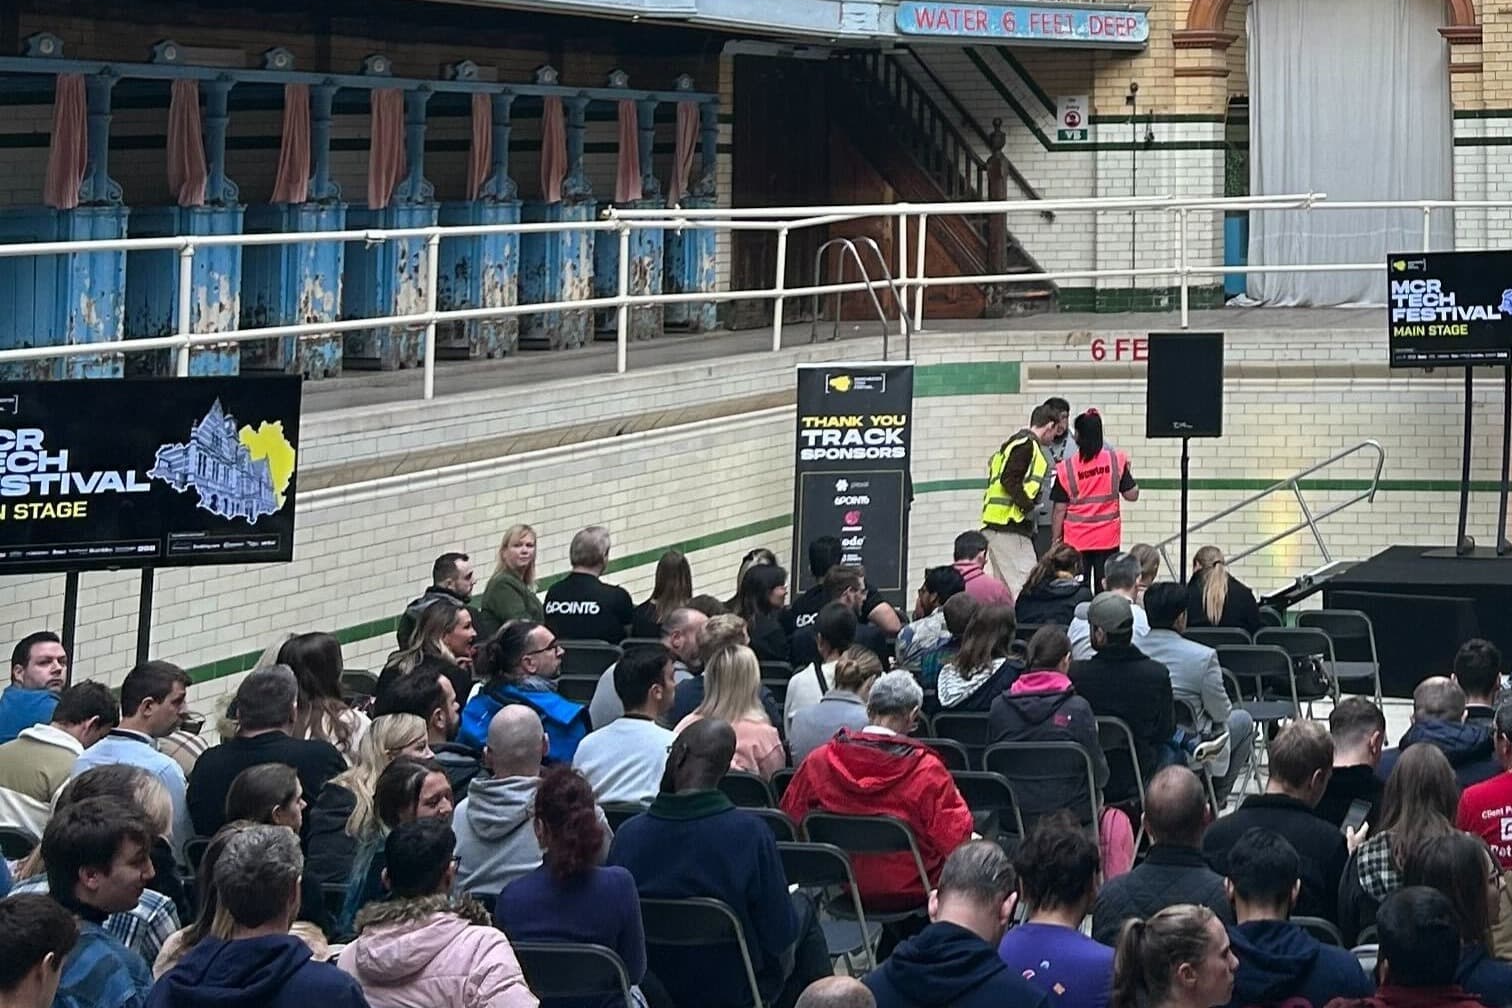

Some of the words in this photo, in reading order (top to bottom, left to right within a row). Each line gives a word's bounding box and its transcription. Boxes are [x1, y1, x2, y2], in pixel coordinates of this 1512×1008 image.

[914, 7, 987, 32] WATER
[1002, 11, 1016, 33] 6
[1030, 13, 1073, 35] FEET
[1088, 15, 1137, 37] DEEP
[1391, 279, 1442, 294] MCR
[1392, 292, 1456, 307] TECH
[1392, 305, 1502, 322] FESTIVAL
[1393, 325, 1425, 336] MAIN
[1428, 324, 1469, 336] STAGE
[1091, 338, 1106, 361] 6
[1115, 338, 1148, 361] FE
[801, 415, 863, 429] THANK
[870, 414, 906, 427] YOU
[0, 428, 45, 450] CR
[801, 427, 905, 447] TRACK
[800, 446, 906, 460] SPONSORS
[0, 470, 150, 496] STIVAL
[14, 501, 88, 519] STAGE
[1481, 806, 1504, 819] Client
